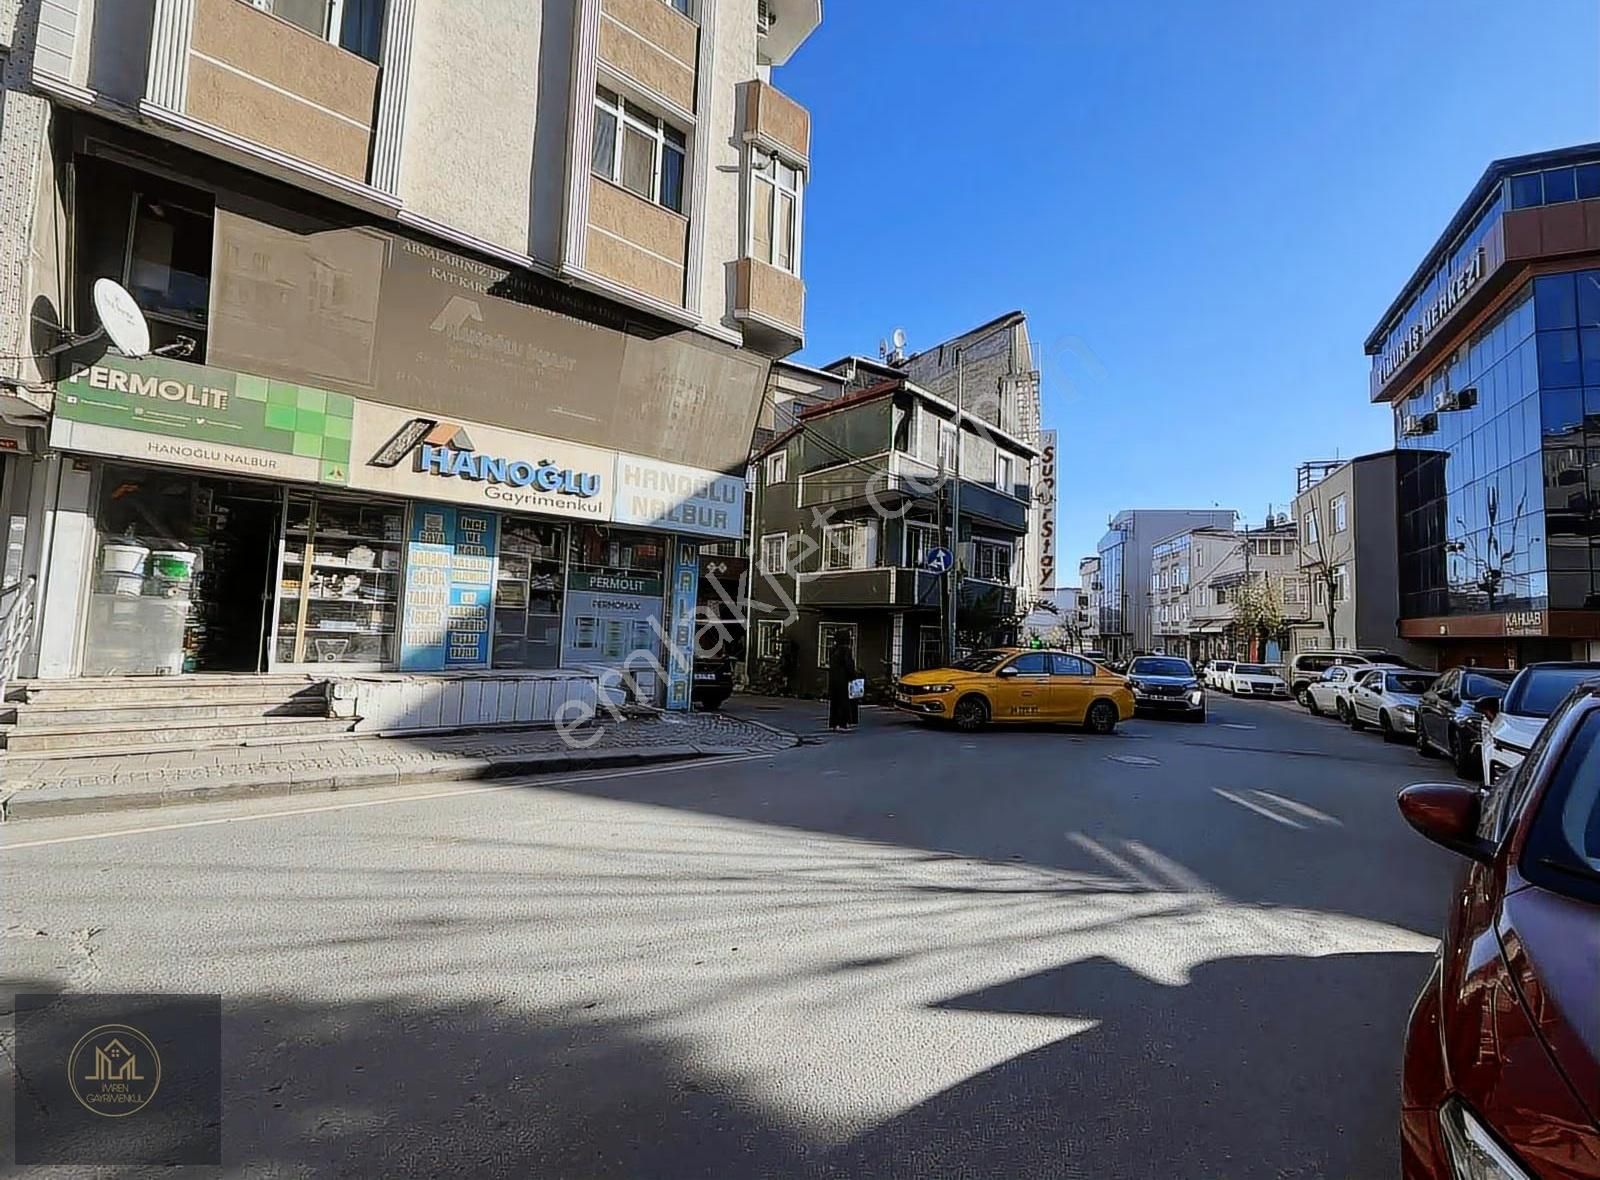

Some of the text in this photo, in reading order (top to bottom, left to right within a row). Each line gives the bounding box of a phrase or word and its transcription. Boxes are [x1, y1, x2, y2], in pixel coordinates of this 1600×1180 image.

[224, 453, 277, 469] NALBUR
[417, 444, 601, 498] HANOĞLU
[484, 485, 603, 515] Gayrimenkul
[631, 495, 728, 529] NALBUR
[1040, 445, 1055, 586] SurStay
